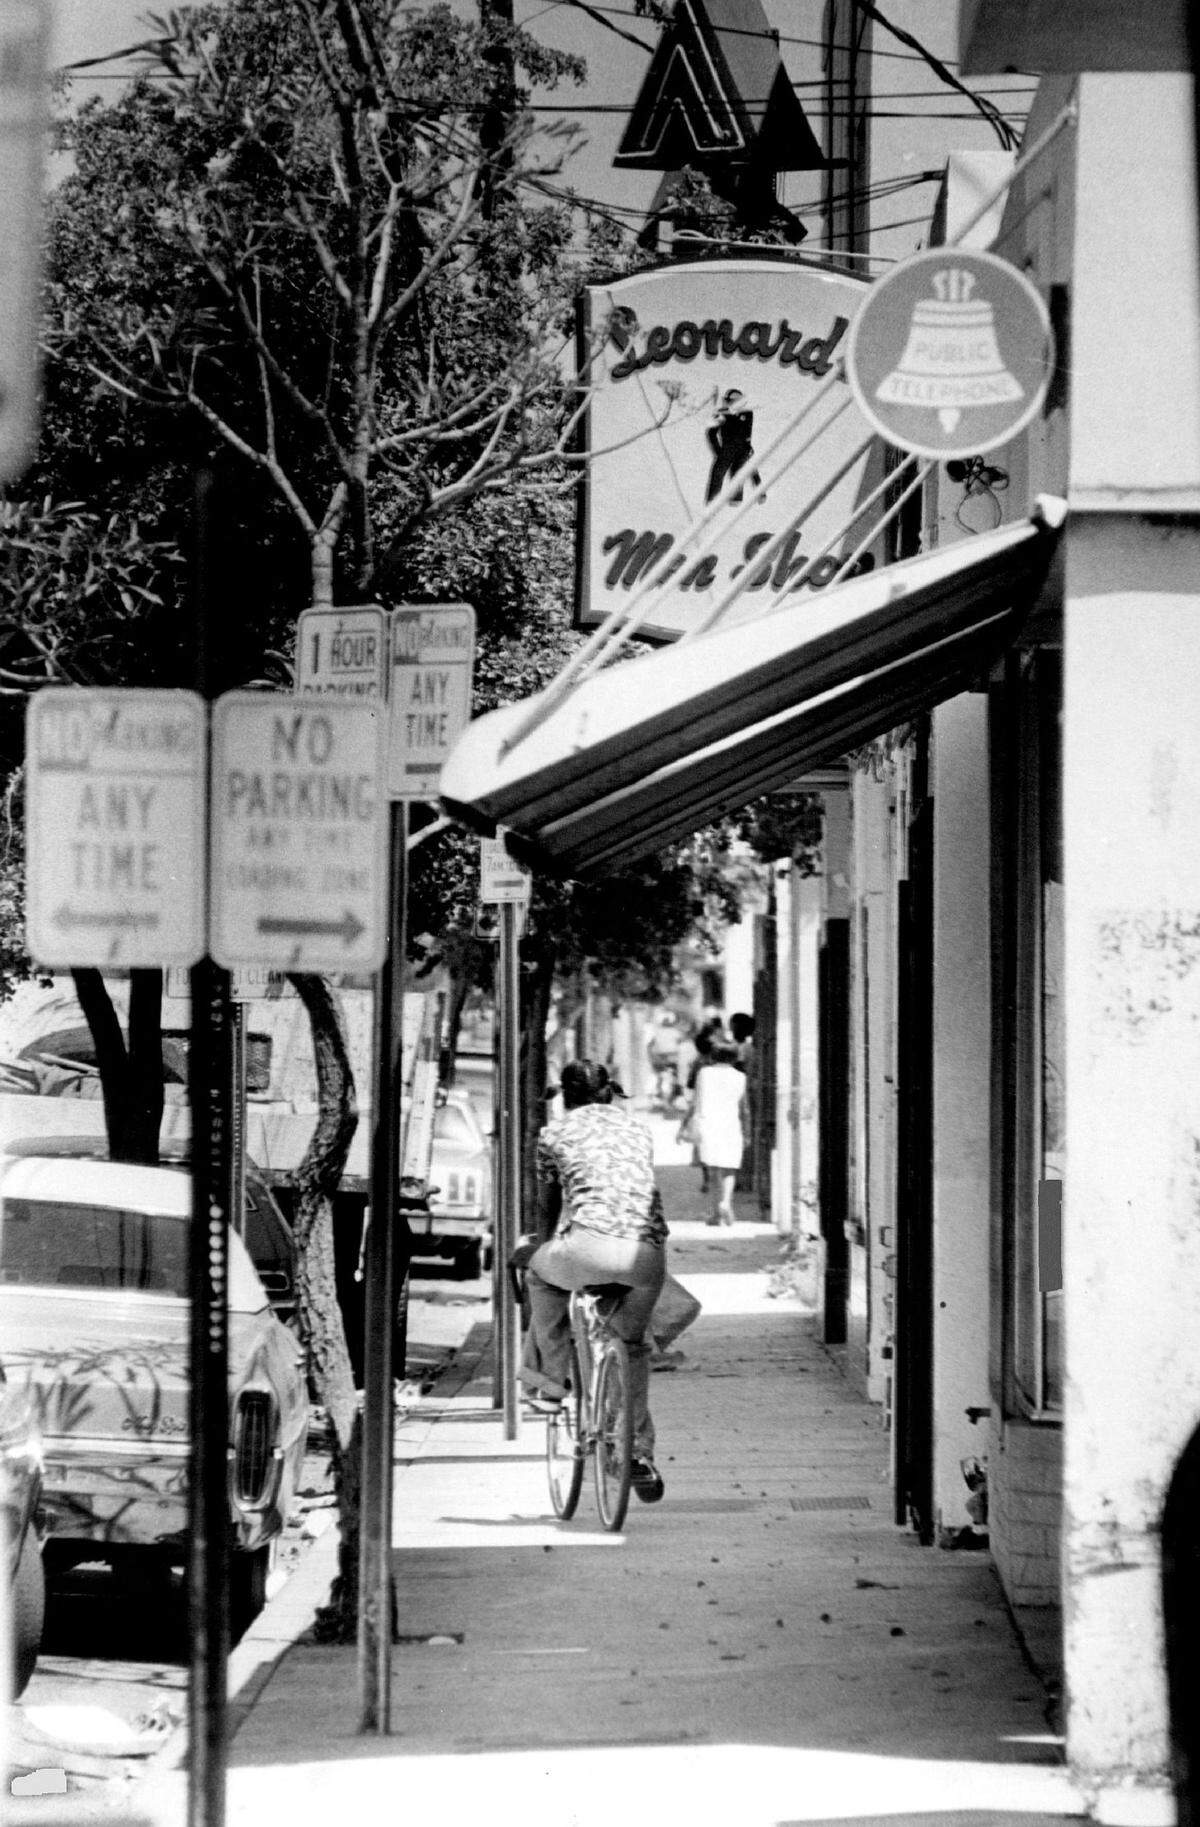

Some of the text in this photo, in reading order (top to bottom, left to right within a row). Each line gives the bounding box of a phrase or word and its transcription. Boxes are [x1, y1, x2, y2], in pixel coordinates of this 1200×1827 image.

[914, 340, 991, 363] PUBLIC
[890, 376, 1012, 401] TELEPHONE
[312, 632, 377, 675] 1 HOUR
[413, 671, 450, 705] ANY
[271, 714, 335, 766] NO
[406, 713, 448, 747] TIME
[76, 783, 157, 830] ANY
[227, 769, 375, 822] PARKING
[71, 843, 161, 890] TIME
